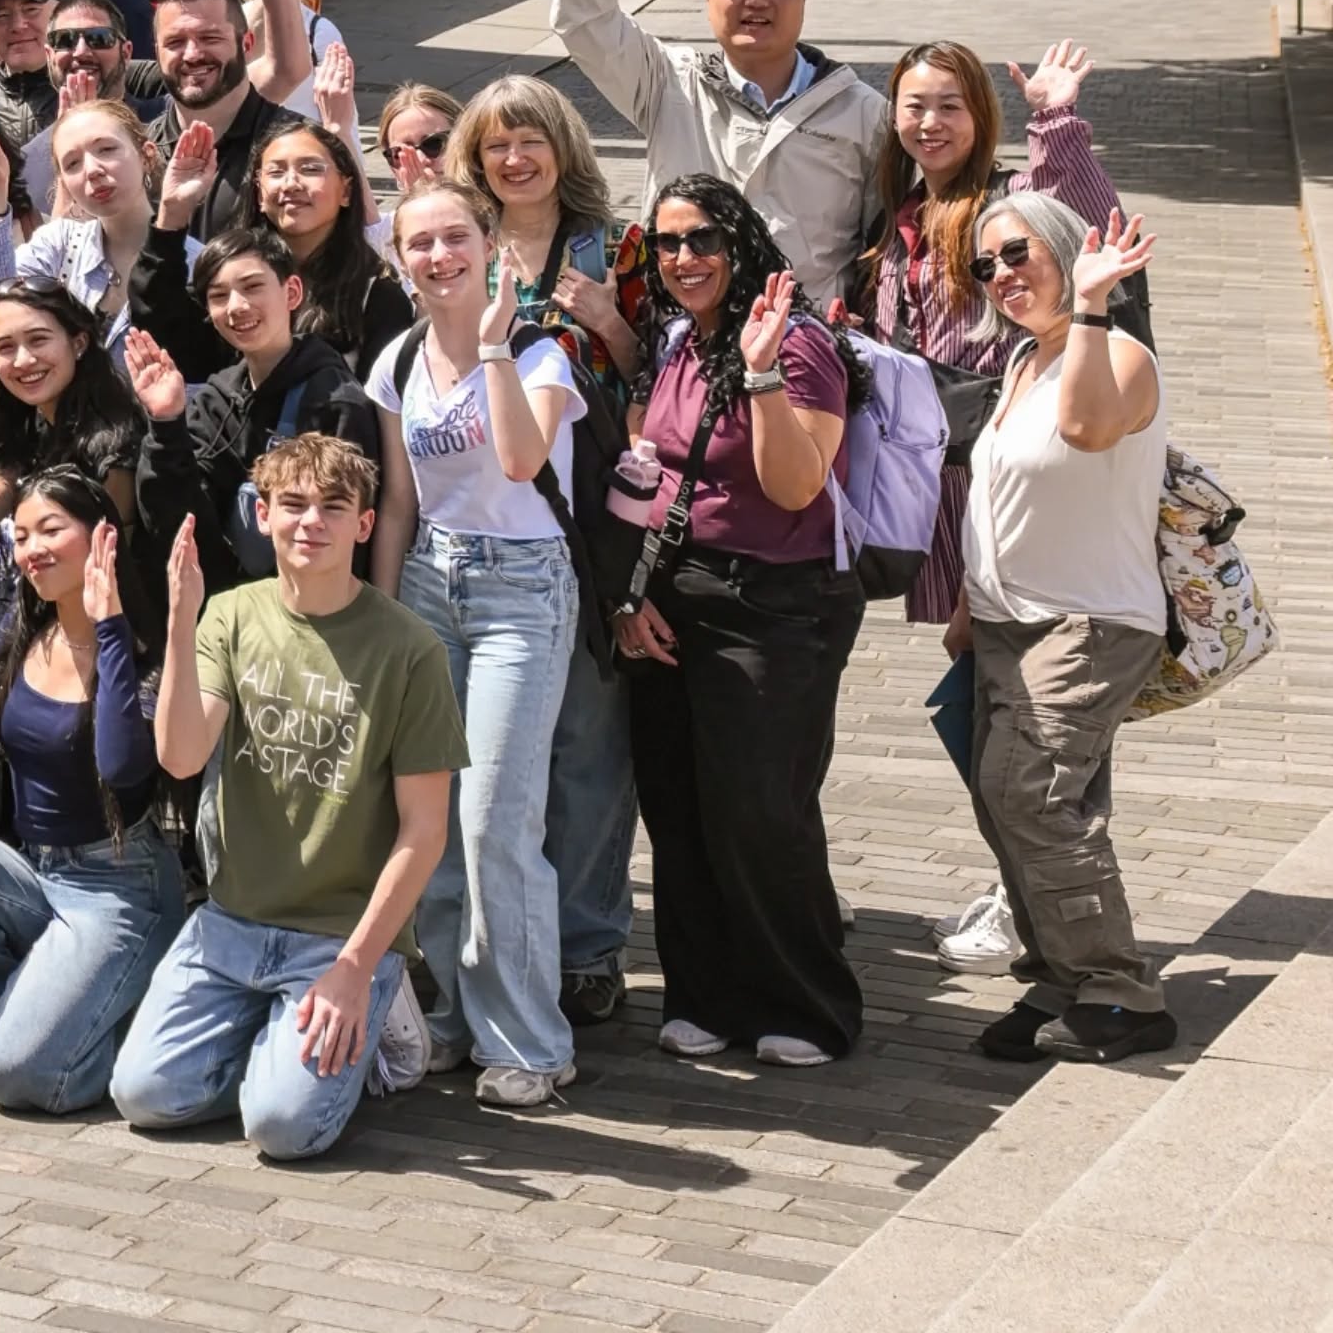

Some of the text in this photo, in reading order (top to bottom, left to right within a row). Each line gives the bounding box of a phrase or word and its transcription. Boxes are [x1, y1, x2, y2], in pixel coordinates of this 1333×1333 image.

[237, 660, 362, 717] ALL THE
[243, 700, 356, 756] WORLD'S
[234, 736, 351, 795] A STAGE
